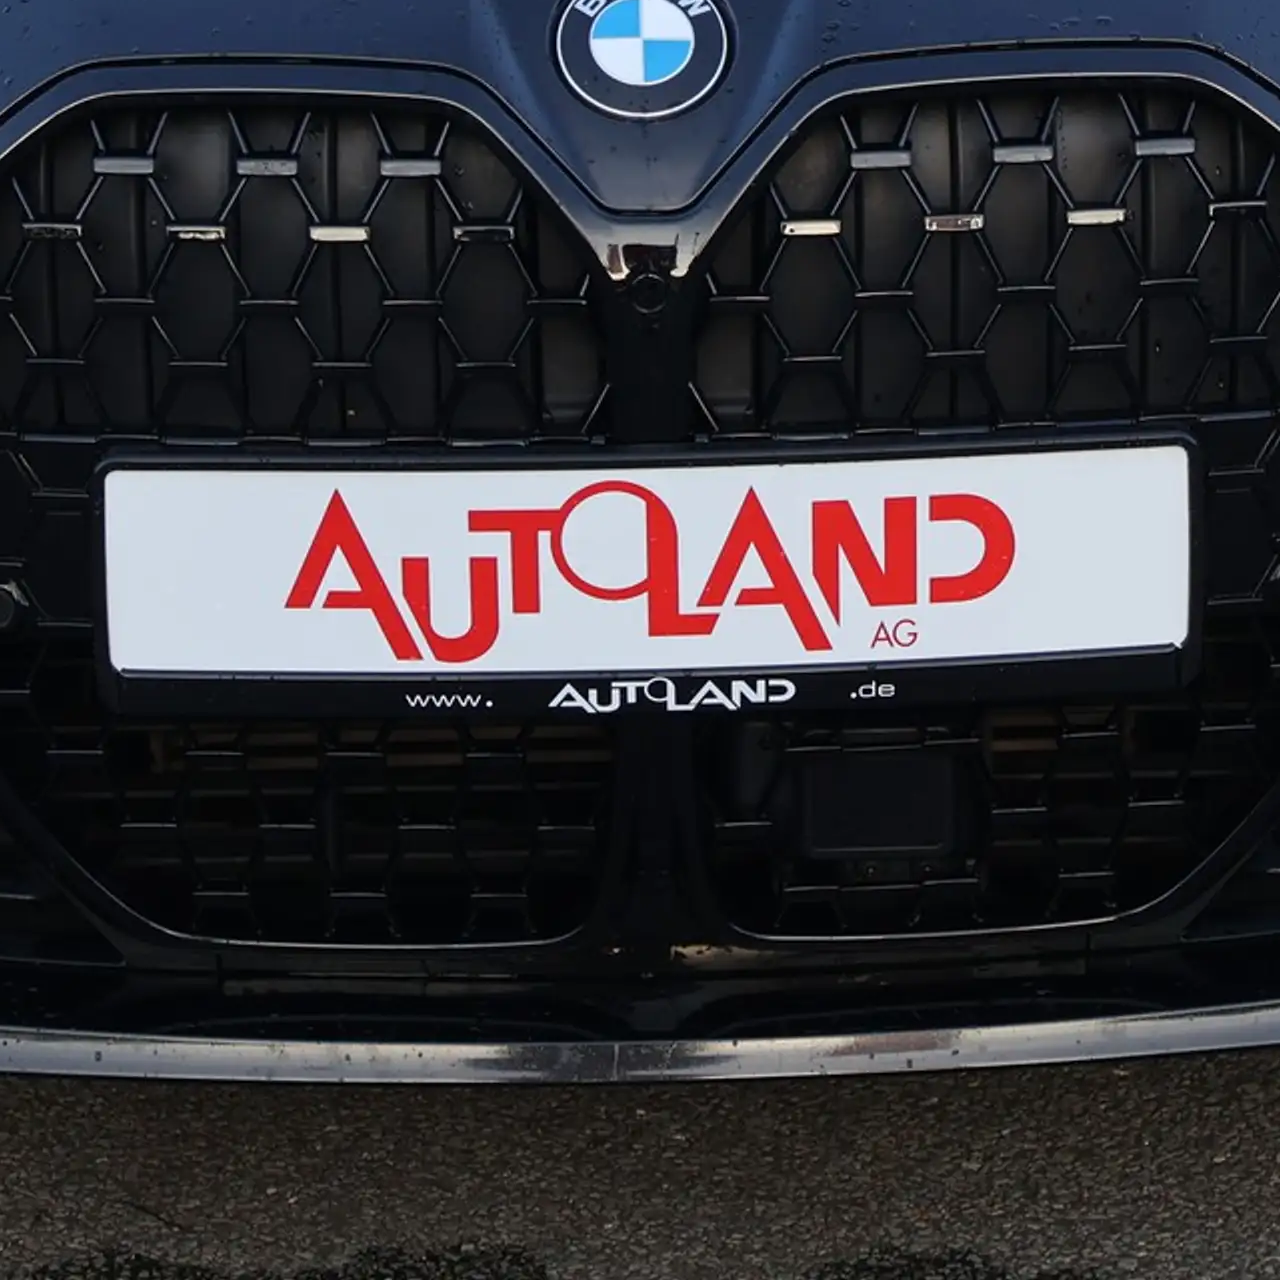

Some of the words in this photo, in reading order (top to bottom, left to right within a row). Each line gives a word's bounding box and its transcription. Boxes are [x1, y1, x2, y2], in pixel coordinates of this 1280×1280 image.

[285, 480, 1016, 664] AUTOLAND
[872, 619, 918, 649] AG
[406, 693, 494, 708] www.
[850, 680, 896, 699] .de
